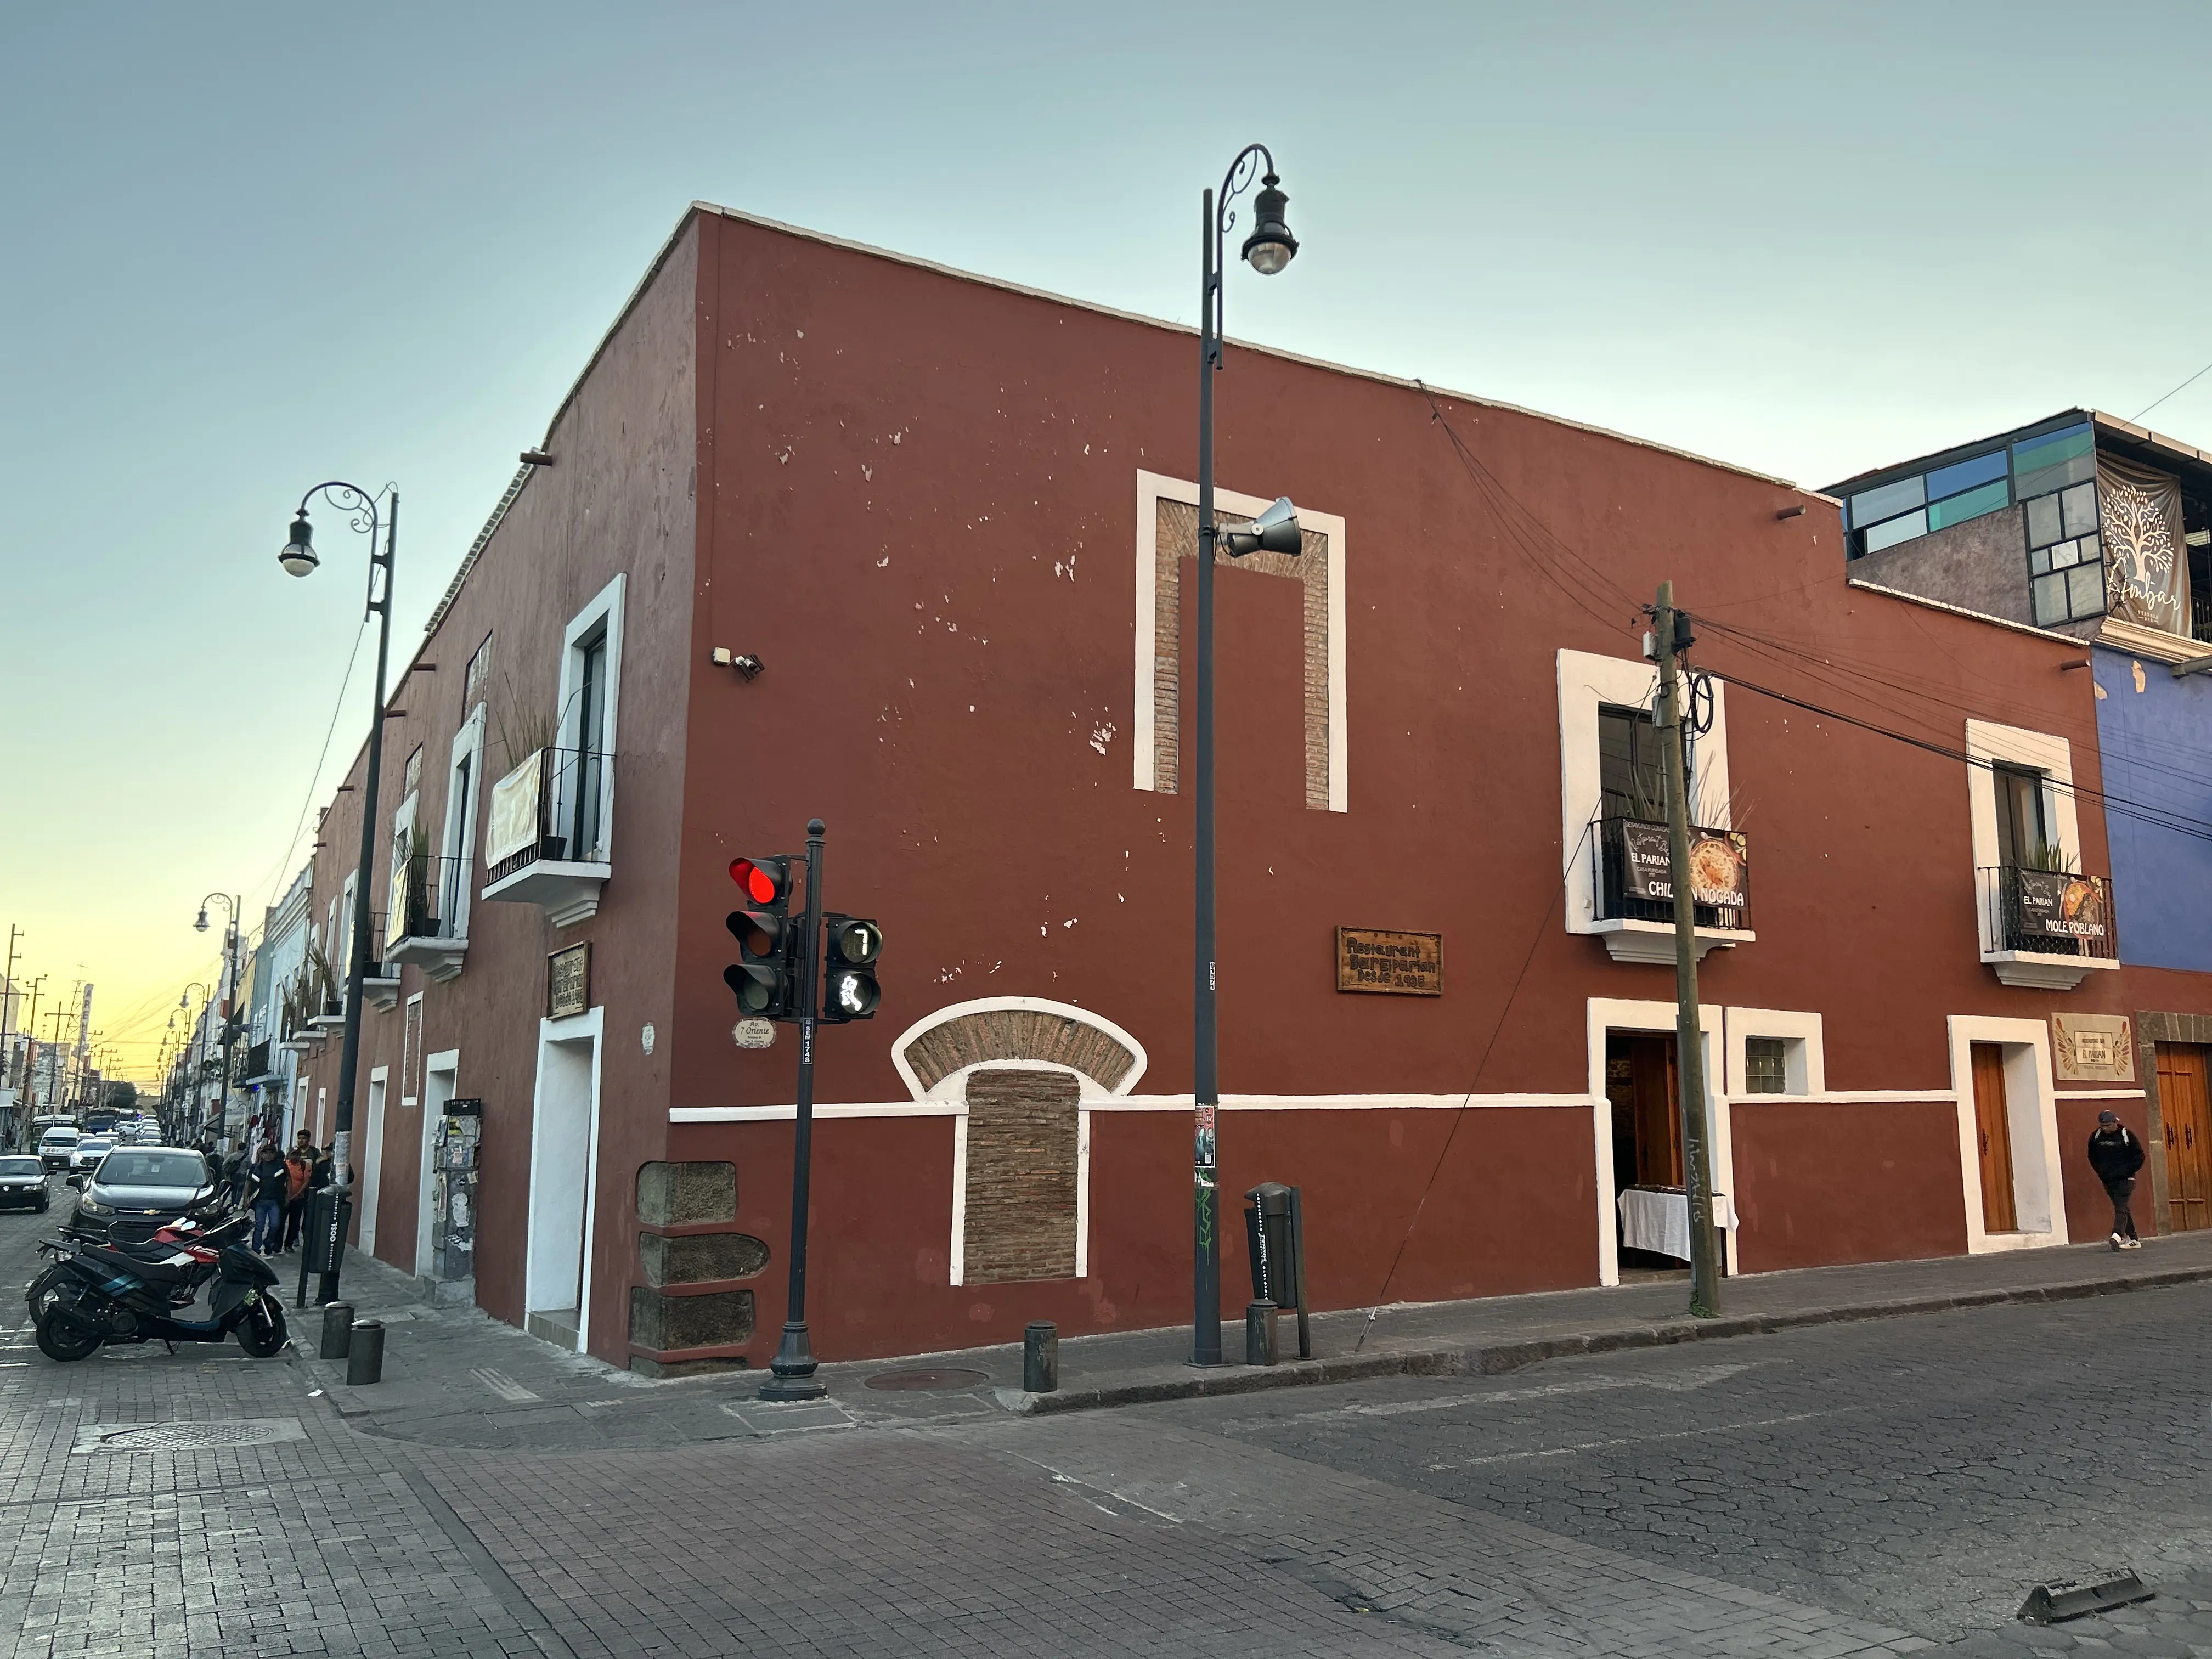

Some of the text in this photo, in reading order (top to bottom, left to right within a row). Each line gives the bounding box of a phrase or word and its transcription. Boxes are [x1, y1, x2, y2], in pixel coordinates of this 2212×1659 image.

[1631, 852, 1641, 863] EL
[1701, 887, 1745, 906] NOGADA
[2024, 896, 2053, 906] EL PARIAN
[2046, 919, 2068, 933] MOLE
[2069, 921, 2104, 936] POBLANO
[855, 929, 868, 956] 7
[1347, 937, 1421, 958] Restaurant
[1357, 969, 1425, 988] Desde 1935
